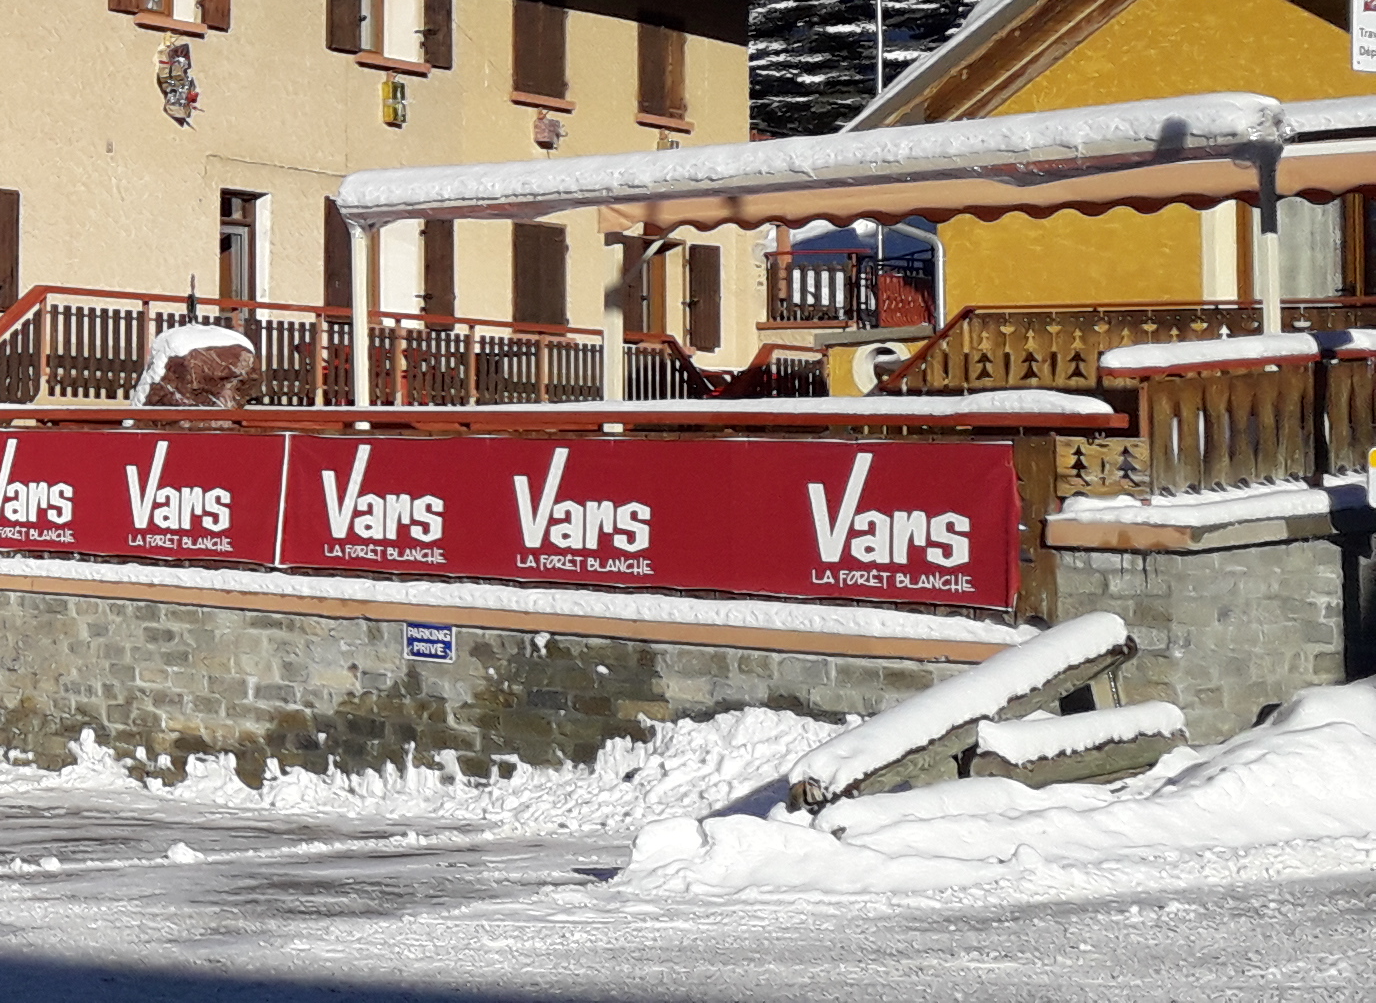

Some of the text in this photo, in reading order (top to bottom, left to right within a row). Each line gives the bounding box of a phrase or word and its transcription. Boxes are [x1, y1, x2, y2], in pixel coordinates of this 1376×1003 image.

[125, 440, 231, 533] Vars
[321, 444, 444, 543] Vars
[513, 447, 652, 553] Vars
[807, 452, 971, 568] Vars
[29, 527, 76, 544] BLANCHE
[128, 533, 235, 552] LA FORÊT BLANCHE
[324, 543, 448, 565] LA FORÊT BLANCHE
[516, 553, 656, 576] LA FORÊT BLANCHE
[811, 568, 976, 594] LA FORÊT BLANCHE
[408, 627, 451, 642] PARKING
